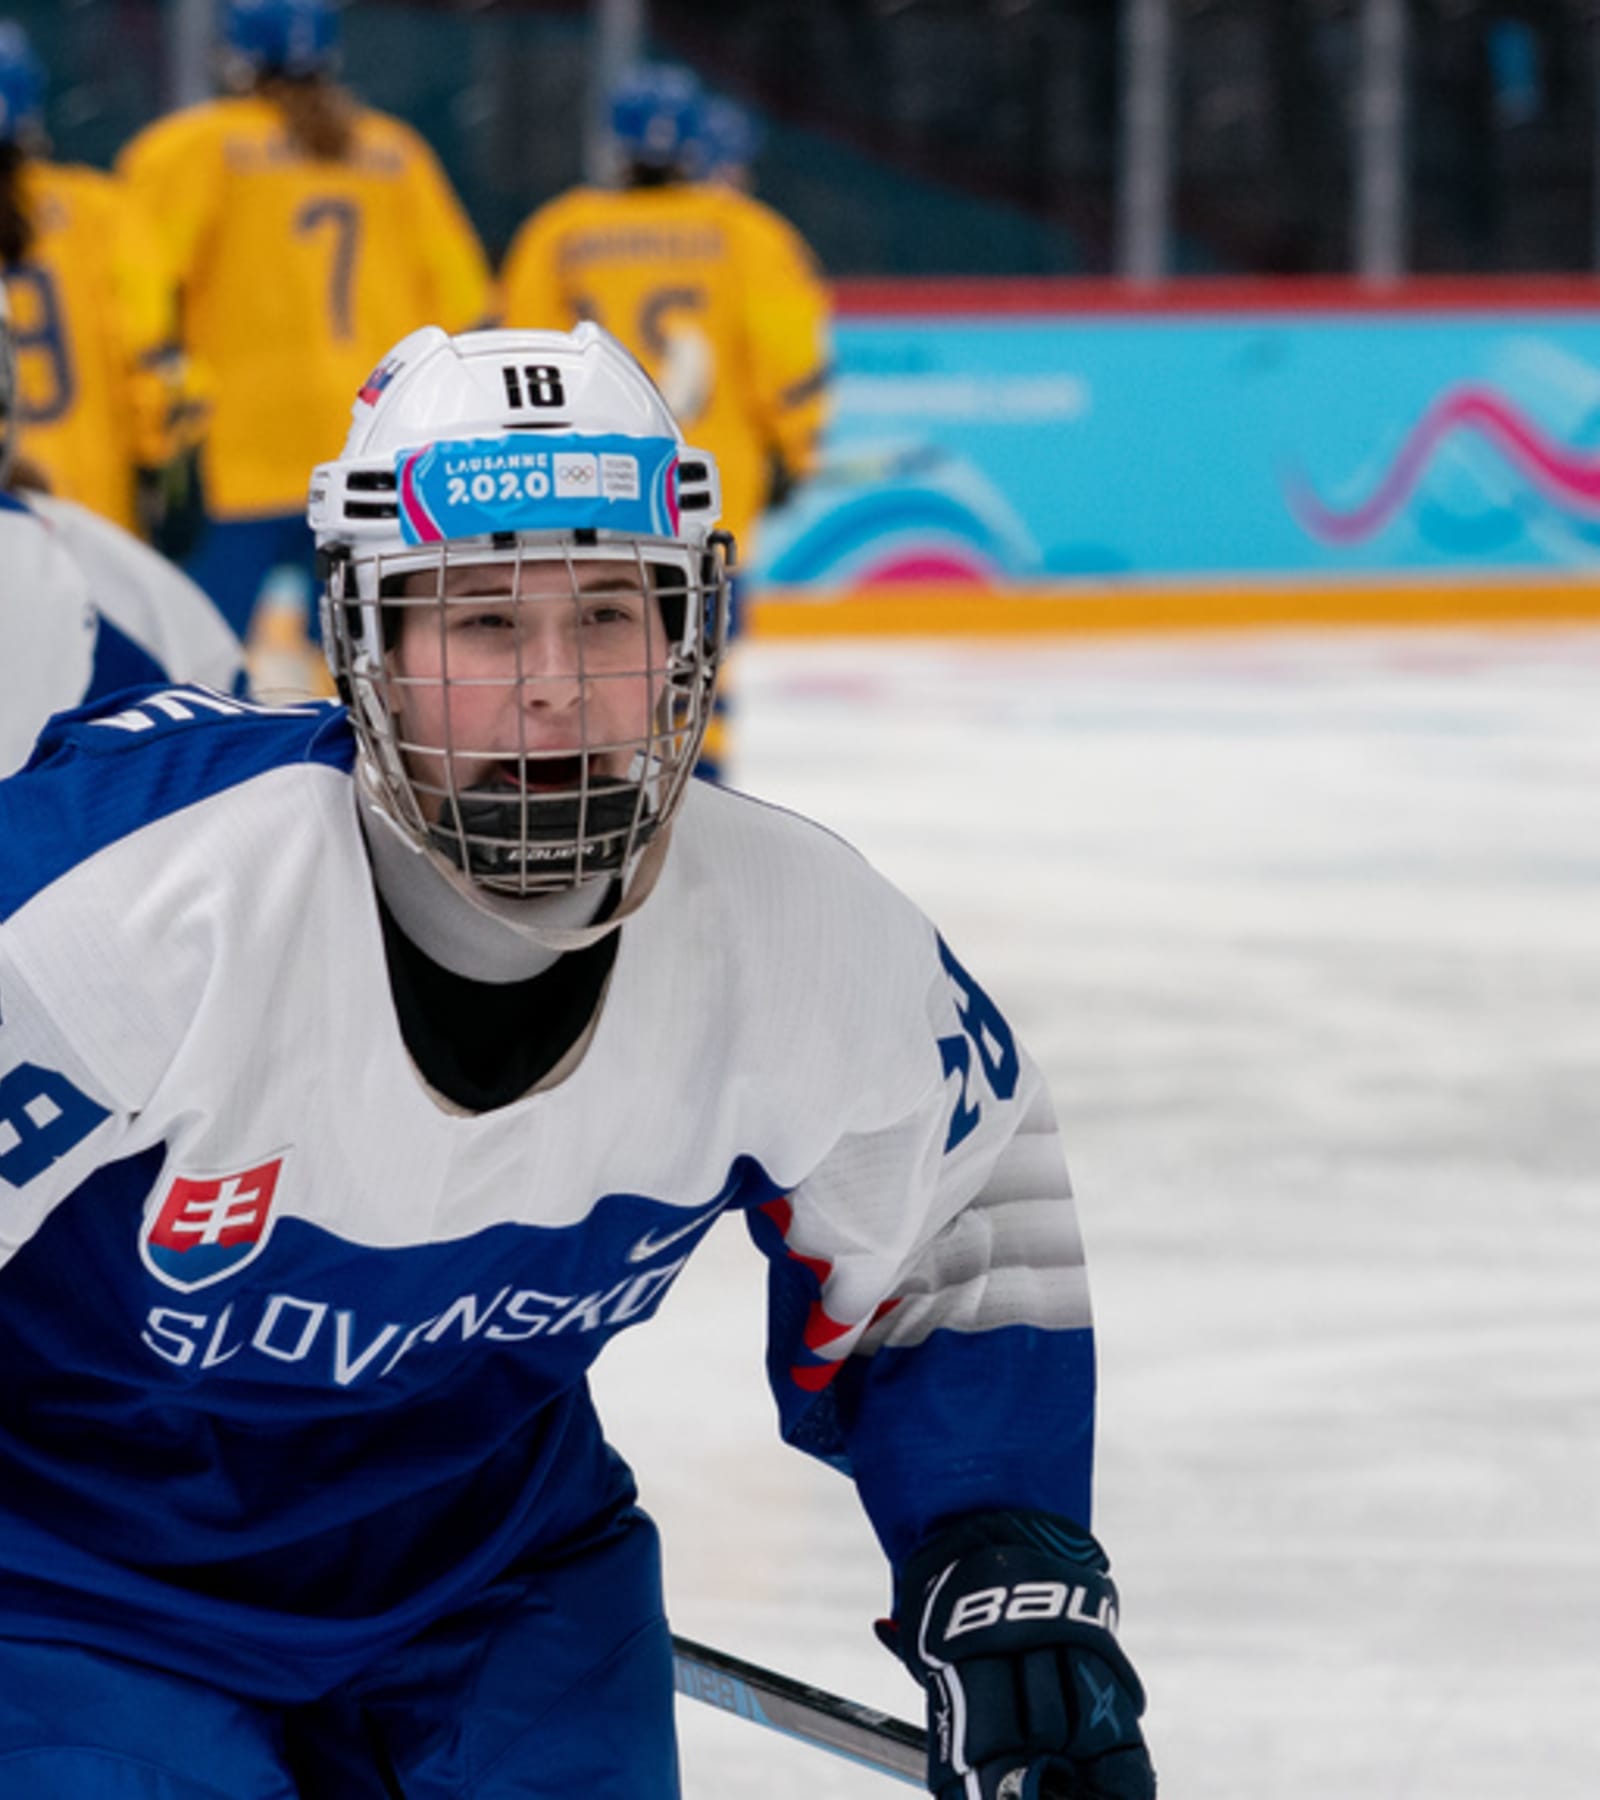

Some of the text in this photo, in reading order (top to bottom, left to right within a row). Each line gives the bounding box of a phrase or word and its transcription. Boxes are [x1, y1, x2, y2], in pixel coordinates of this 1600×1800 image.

[292, 194, 364, 342] 7
[502, 364, 566, 409] 18
[445, 452, 548, 475] LAUSANNE
[446, 470, 550, 506] 2020
[140, 1253, 690, 1387] SLOVNSKO
